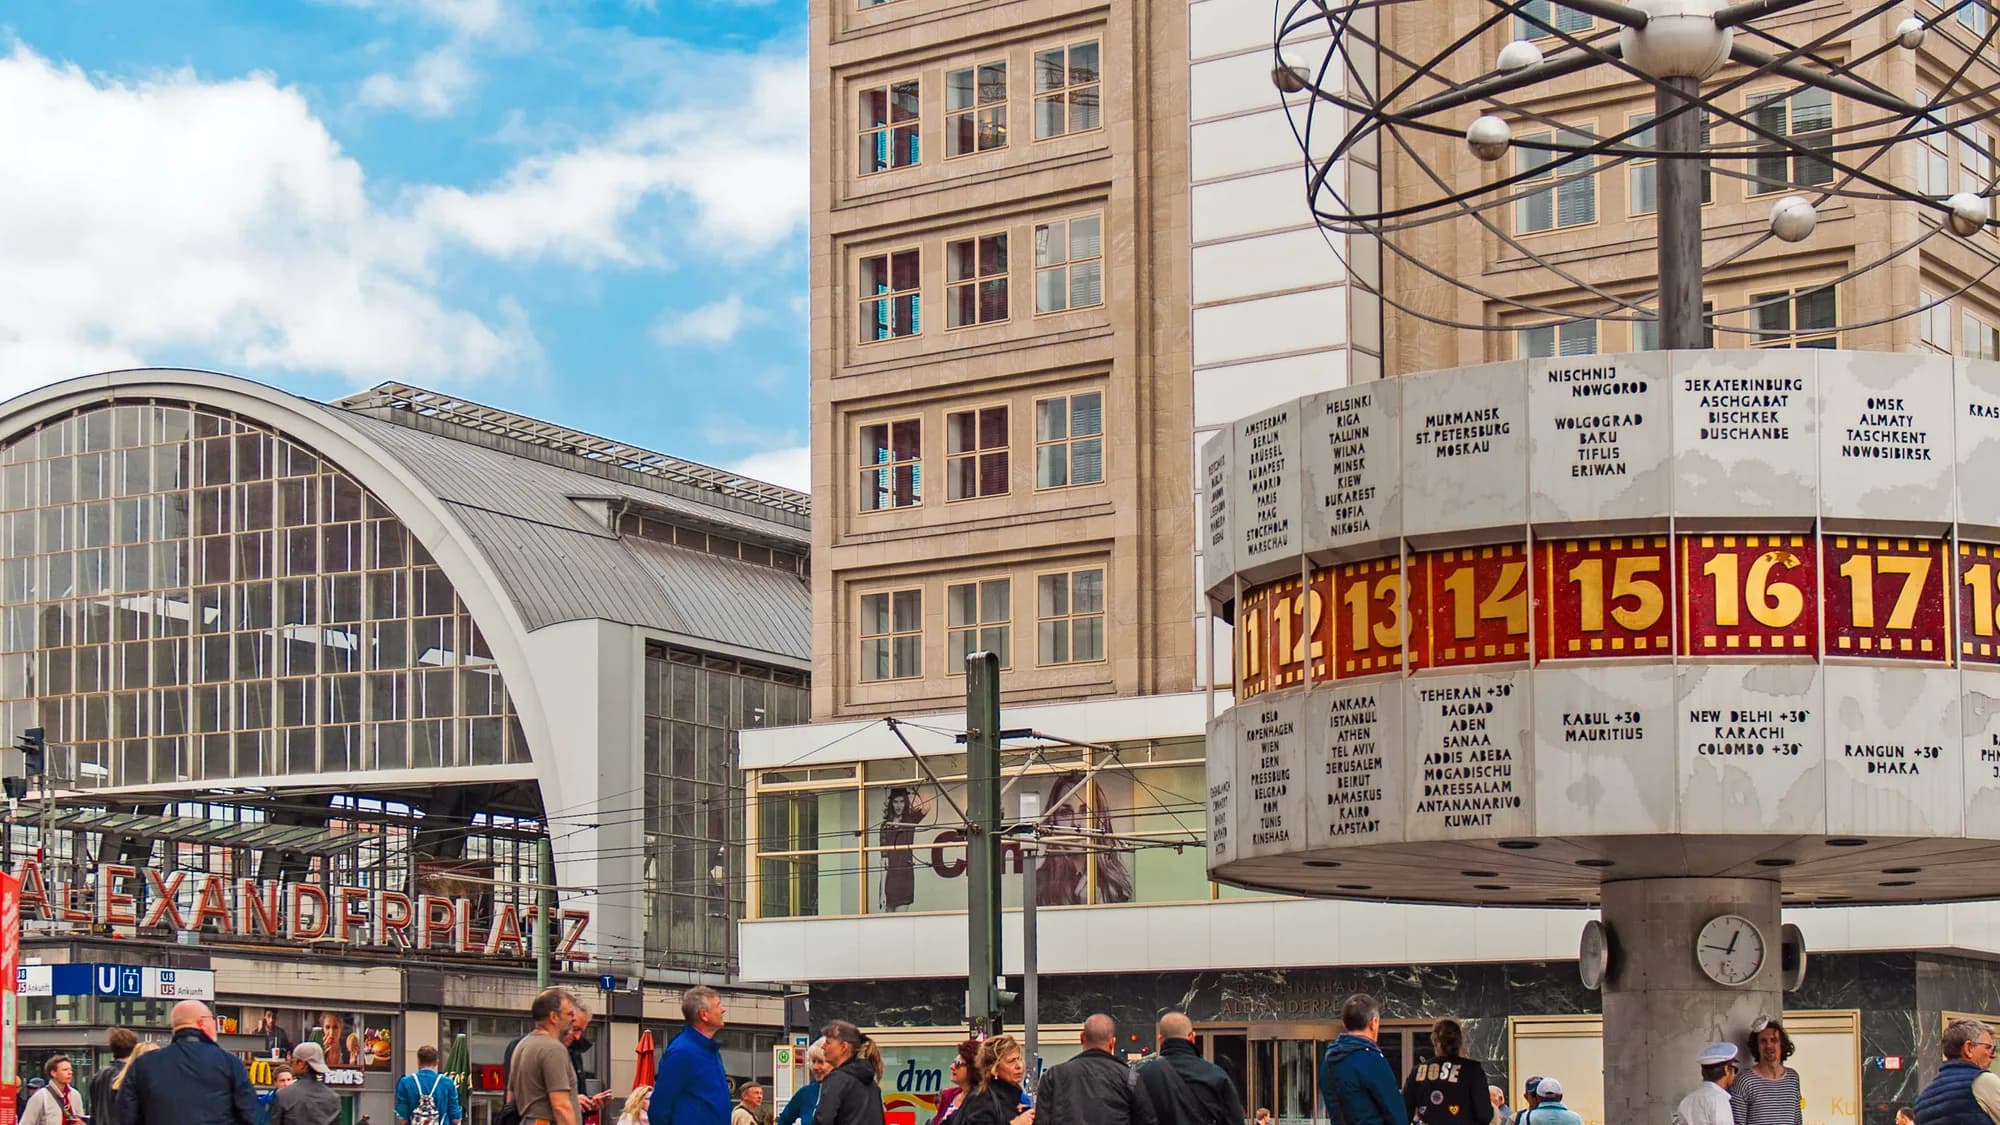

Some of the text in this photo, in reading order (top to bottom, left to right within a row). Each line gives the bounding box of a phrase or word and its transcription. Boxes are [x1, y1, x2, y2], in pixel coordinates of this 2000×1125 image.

[1548, 367, 1616, 383] NISCHNIJ
[1572, 381, 1647, 397] NOWGOROD
[1685, 379, 1802, 392] JEKATERINBURG
[1326, 395, 1372, 415] HELSINKI
[1700, 395, 1788, 407] ASCHGABAT
[1867, 398, 1904, 411] OMSK
[1245, 412, 1287, 436] AMSTERDAM
[1337, 413, 1360, 428] RIGA
[1426, 408, 1500, 428] MURMANSK
[1555, 414, 1643, 430] WOLGOGRAD
[1708, 411, 1779, 423] BISCHKEK
[1859, 413, 1913, 427] ALMATY
[1253, 431, 1279, 449] BERLIN
[1329, 426, 1369, 445] TALLINN
[1416, 422, 1510, 444] ST. PETERSBURG
[1580, 431, 1617, 444] BAKU
[1700, 428, 1789, 440] DUSCHANBE
[1846, 429, 1926, 444] TASCHKENT
[1334, 443, 1365, 458] WILNA
[1436, 440, 1490, 458] MOSKAU
[1578, 447, 1620, 460] TIFLIS
[1842, 445, 1931, 461] NOWOSIBIRSK
[1249, 458, 1285, 480] BUDAPEST
[1333, 458, 1365, 474] MINSK
[1571, 463, 1626, 477] ERIWAN
[1252, 476, 1281, 494] MADRID
[1338, 474, 1361, 489] KIEW
[1257, 492, 1277, 508] PARIS
[1325, 487, 1376, 507] BUKAREST
[1258, 507, 1277, 522] PRAG
[1336, 505, 1364, 520] SOFIA
[1246, 519, 1288, 541] STOCKHOLM
[1331, 519, 1370, 537] NIKOSIA
[1248, 535, 1288, 555] WARSCHAU
[1569, 555, 1664, 632] 15
[1703, 551, 1804, 628] 16
[1840, 554, 1933, 630] 17
[1444, 561, 1528, 639] 14
[1964, 563, 2000, 636] 1
[1344, 573, 1413, 651] 13
[1273, 589, 1323, 666] 12
[1420, 687, 1481, 702] TEHERAN
[1331, 696, 1376, 712] ANKARA
[1441, 702, 1493, 716] BAGDAD
[1261, 711, 1278, 723] OSLO
[1330, 712, 1377, 728] ISTANBUL
[1563, 712, 1640, 726] KABUL +30
[1690, 710, 1721, 723] NEW
[1730, 710, 1772, 722] DELHI
[1450, 718, 1485, 732] ADEN
[1715, 727, 1784, 739] KARACHI
[1247, 723, 1293, 744] KOPENHAGEN
[1337, 728, 1370, 742] ATHEN
[1443, 734, 1491, 748] SANAA
[1565, 727, 1643, 742] MAURITIUS
[1261, 741, 1279, 754] WIEN
[1332, 743, 1375, 758] TEL AVIV
[1698, 743, 1764, 756] COLOMBO
[1845, 745, 1905, 758] RANGUN
[1261, 756, 1279, 768] BERN
[1424, 749, 1512, 765] ADDIS ABEBA
[1326, 757, 1382, 775] JERUSALEM
[1424, 765, 1512, 781] MOGADISCHU
[1867, 761, 1919, 775] DHAKA
[1251, 769, 1290, 786] PRESSBURG
[1338, 774, 1370, 788] BEIRUT
[1255, 785, 1286, 800] BELGRAD
[1327, 789, 1382, 805] DAMASKUS
[1424, 781, 1512, 797] DARESSALAM
[1263, 800, 1278, 813] ROM
[1339, 805, 1369, 819] KAIRO
[1416, 796, 1521, 813] ANTANANARIVO
[1260, 815, 1281, 828] TUNIS
[1330, 820, 1380, 836] KAPSTADT
[1444, 814, 1492, 828] KUWAIT
[1252, 829, 1289, 846] KINSHASA
[99, 966, 116, 993] U
[161, 972, 175, 982] U8
[161, 984, 175, 995] U5
[1221, 998, 1341, 1016] ALEXANDERPL
[896, 1059, 942, 1092] dm
[1416, 1062, 1461, 1083] DOSE
